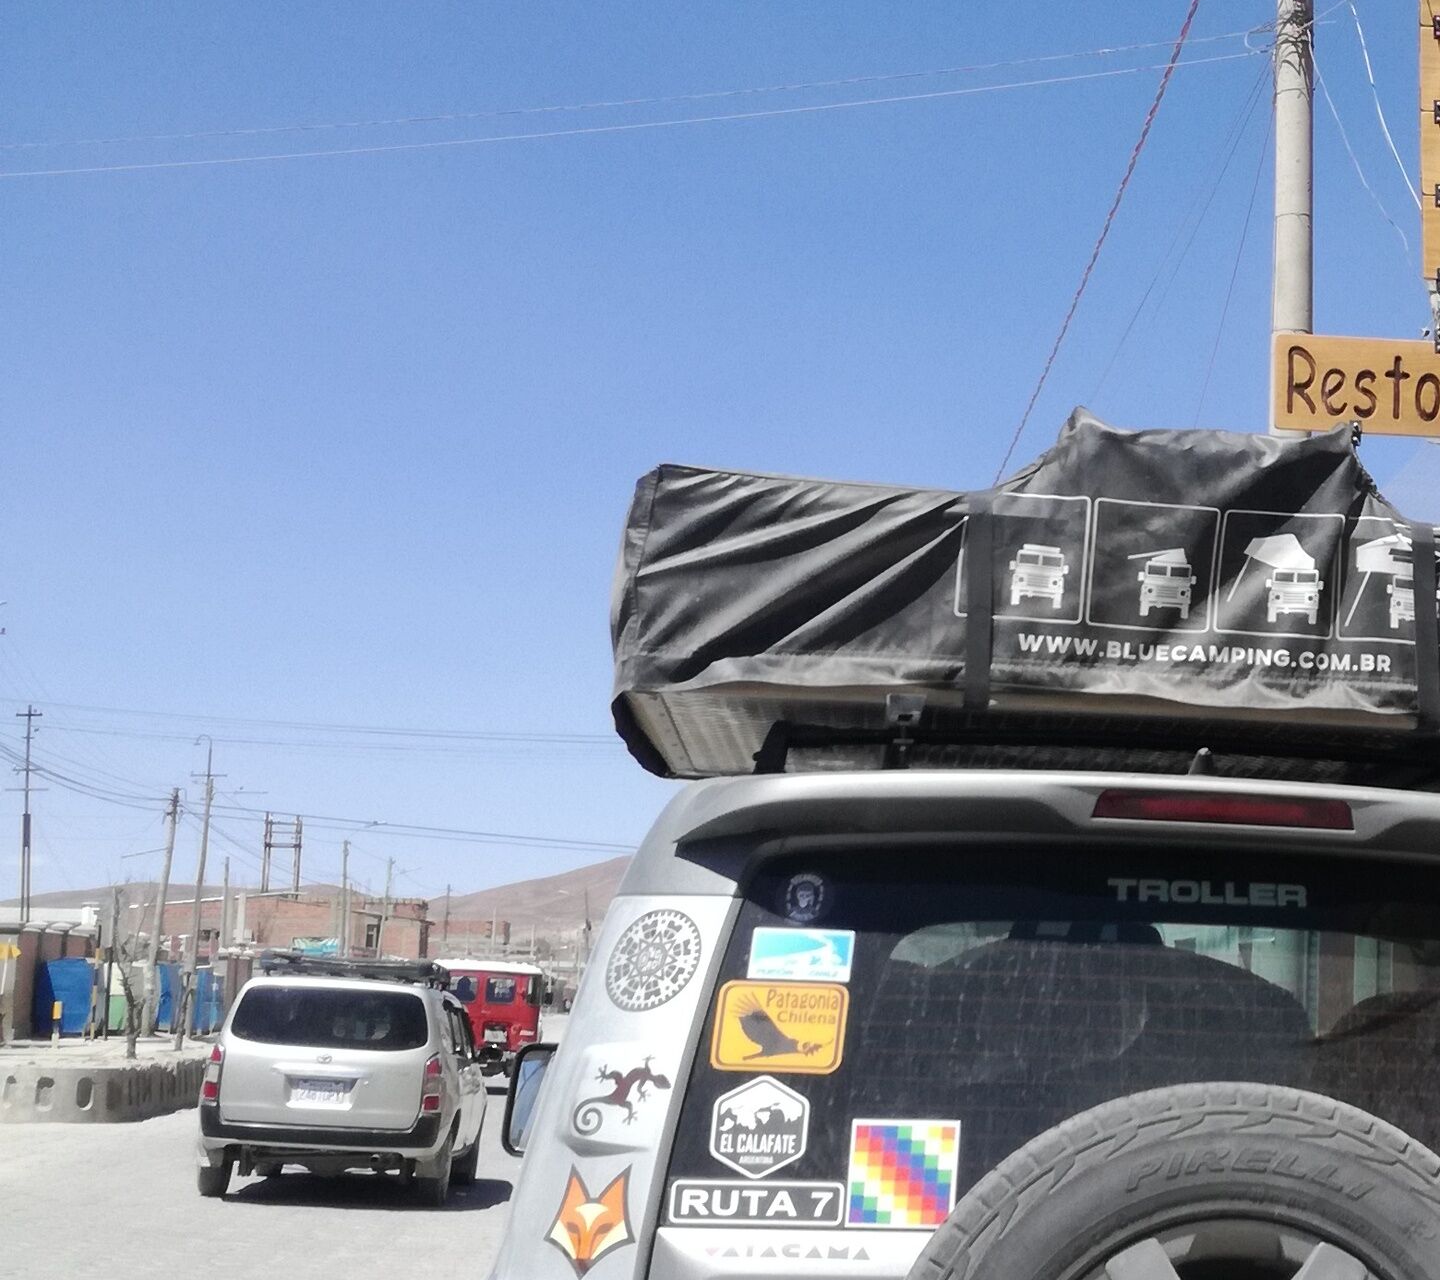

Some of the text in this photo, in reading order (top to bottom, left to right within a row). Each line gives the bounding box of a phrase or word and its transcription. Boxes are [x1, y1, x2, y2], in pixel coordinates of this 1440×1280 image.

[1018, 632, 1393, 673] WWW.BLUECAMPING.COM.BR
[1106, 877, 1308, 908] TROLLER
[766, 988, 839, 1010] Patagonia
[777, 1010, 837, 1025] Chilena
[719, 1133, 797, 1154] EL CALAFATE
[1126, 1147, 1376, 1201] PIRELLI
[680, 1188, 834, 1218] RUTA 7
